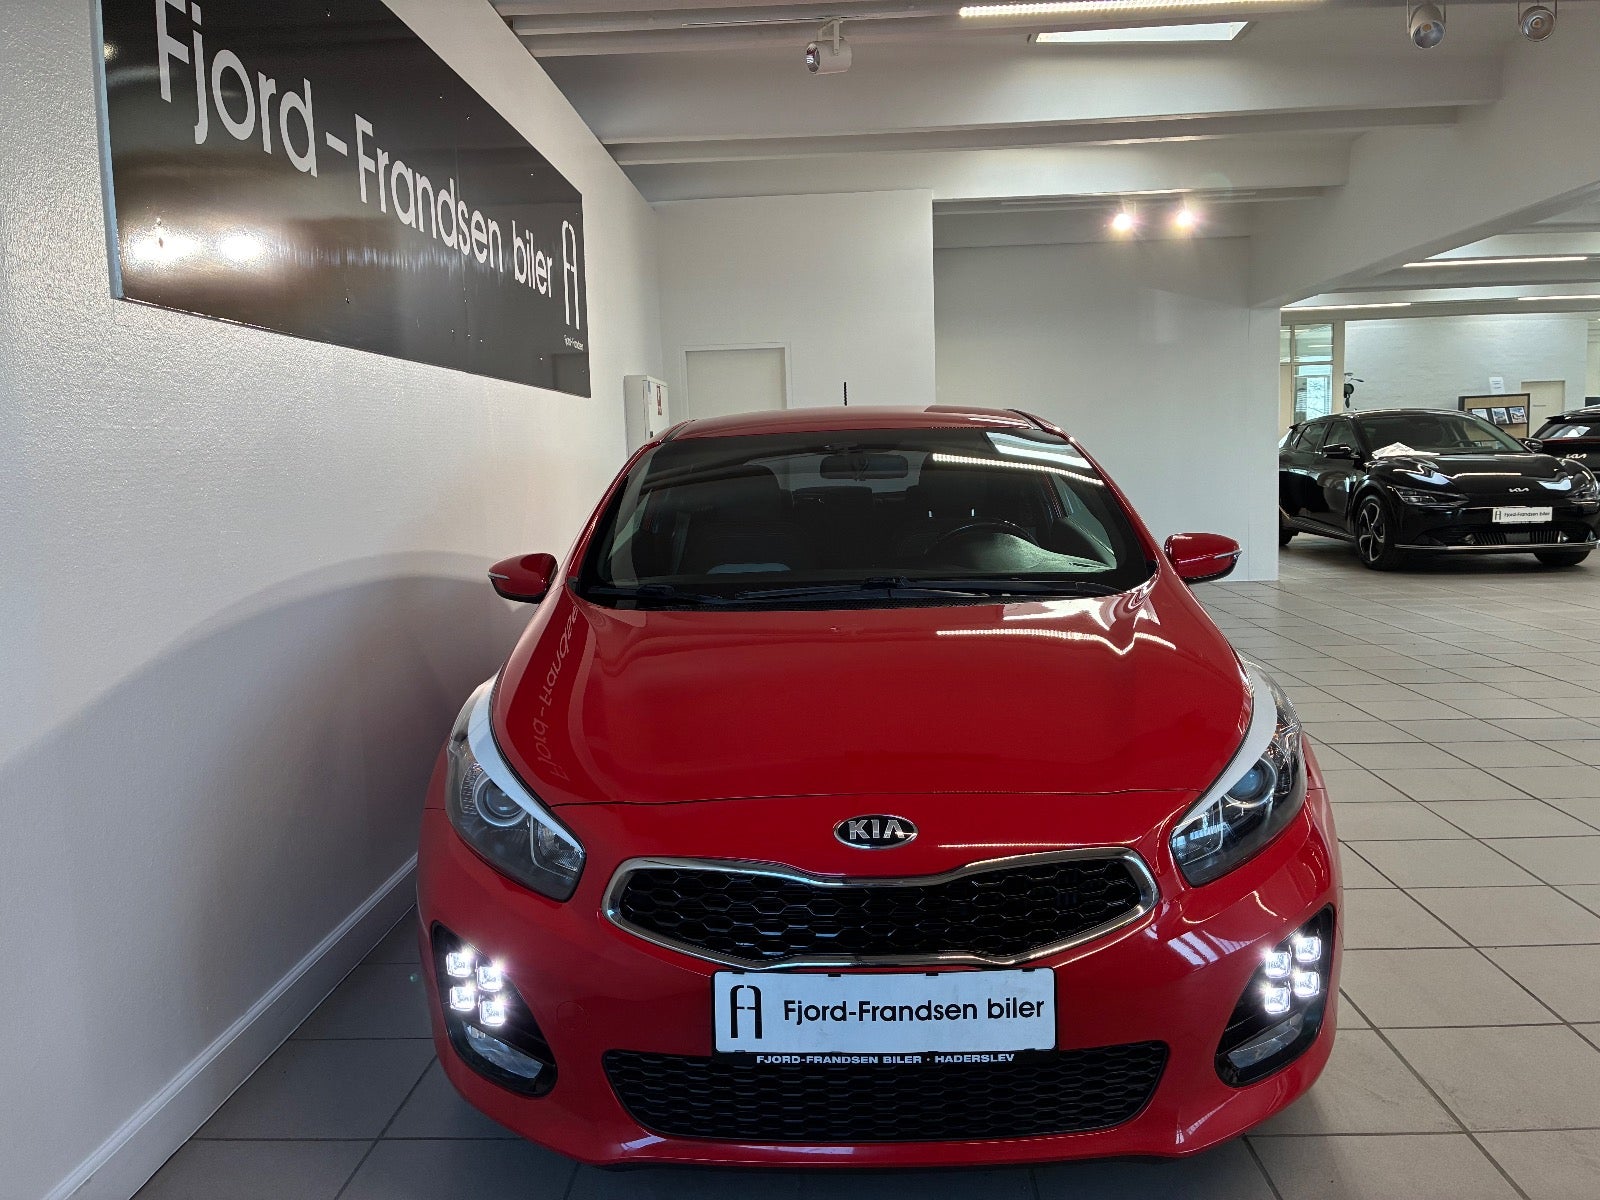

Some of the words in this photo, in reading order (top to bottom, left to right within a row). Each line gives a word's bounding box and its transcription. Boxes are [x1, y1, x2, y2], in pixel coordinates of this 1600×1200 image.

[511, 221, 552, 297] biler
[848, 819, 906, 839] KIA
[783, 1000, 977, 1025] Fjord-Frandsen
[986, 998, 1045, 1019] biler
[756, 1055, 878, 1064] FJORD-FRANDSEN
[882, 1055, 922, 1064] BILER
[934, 1053, 1015, 1063] HADERSLEV
